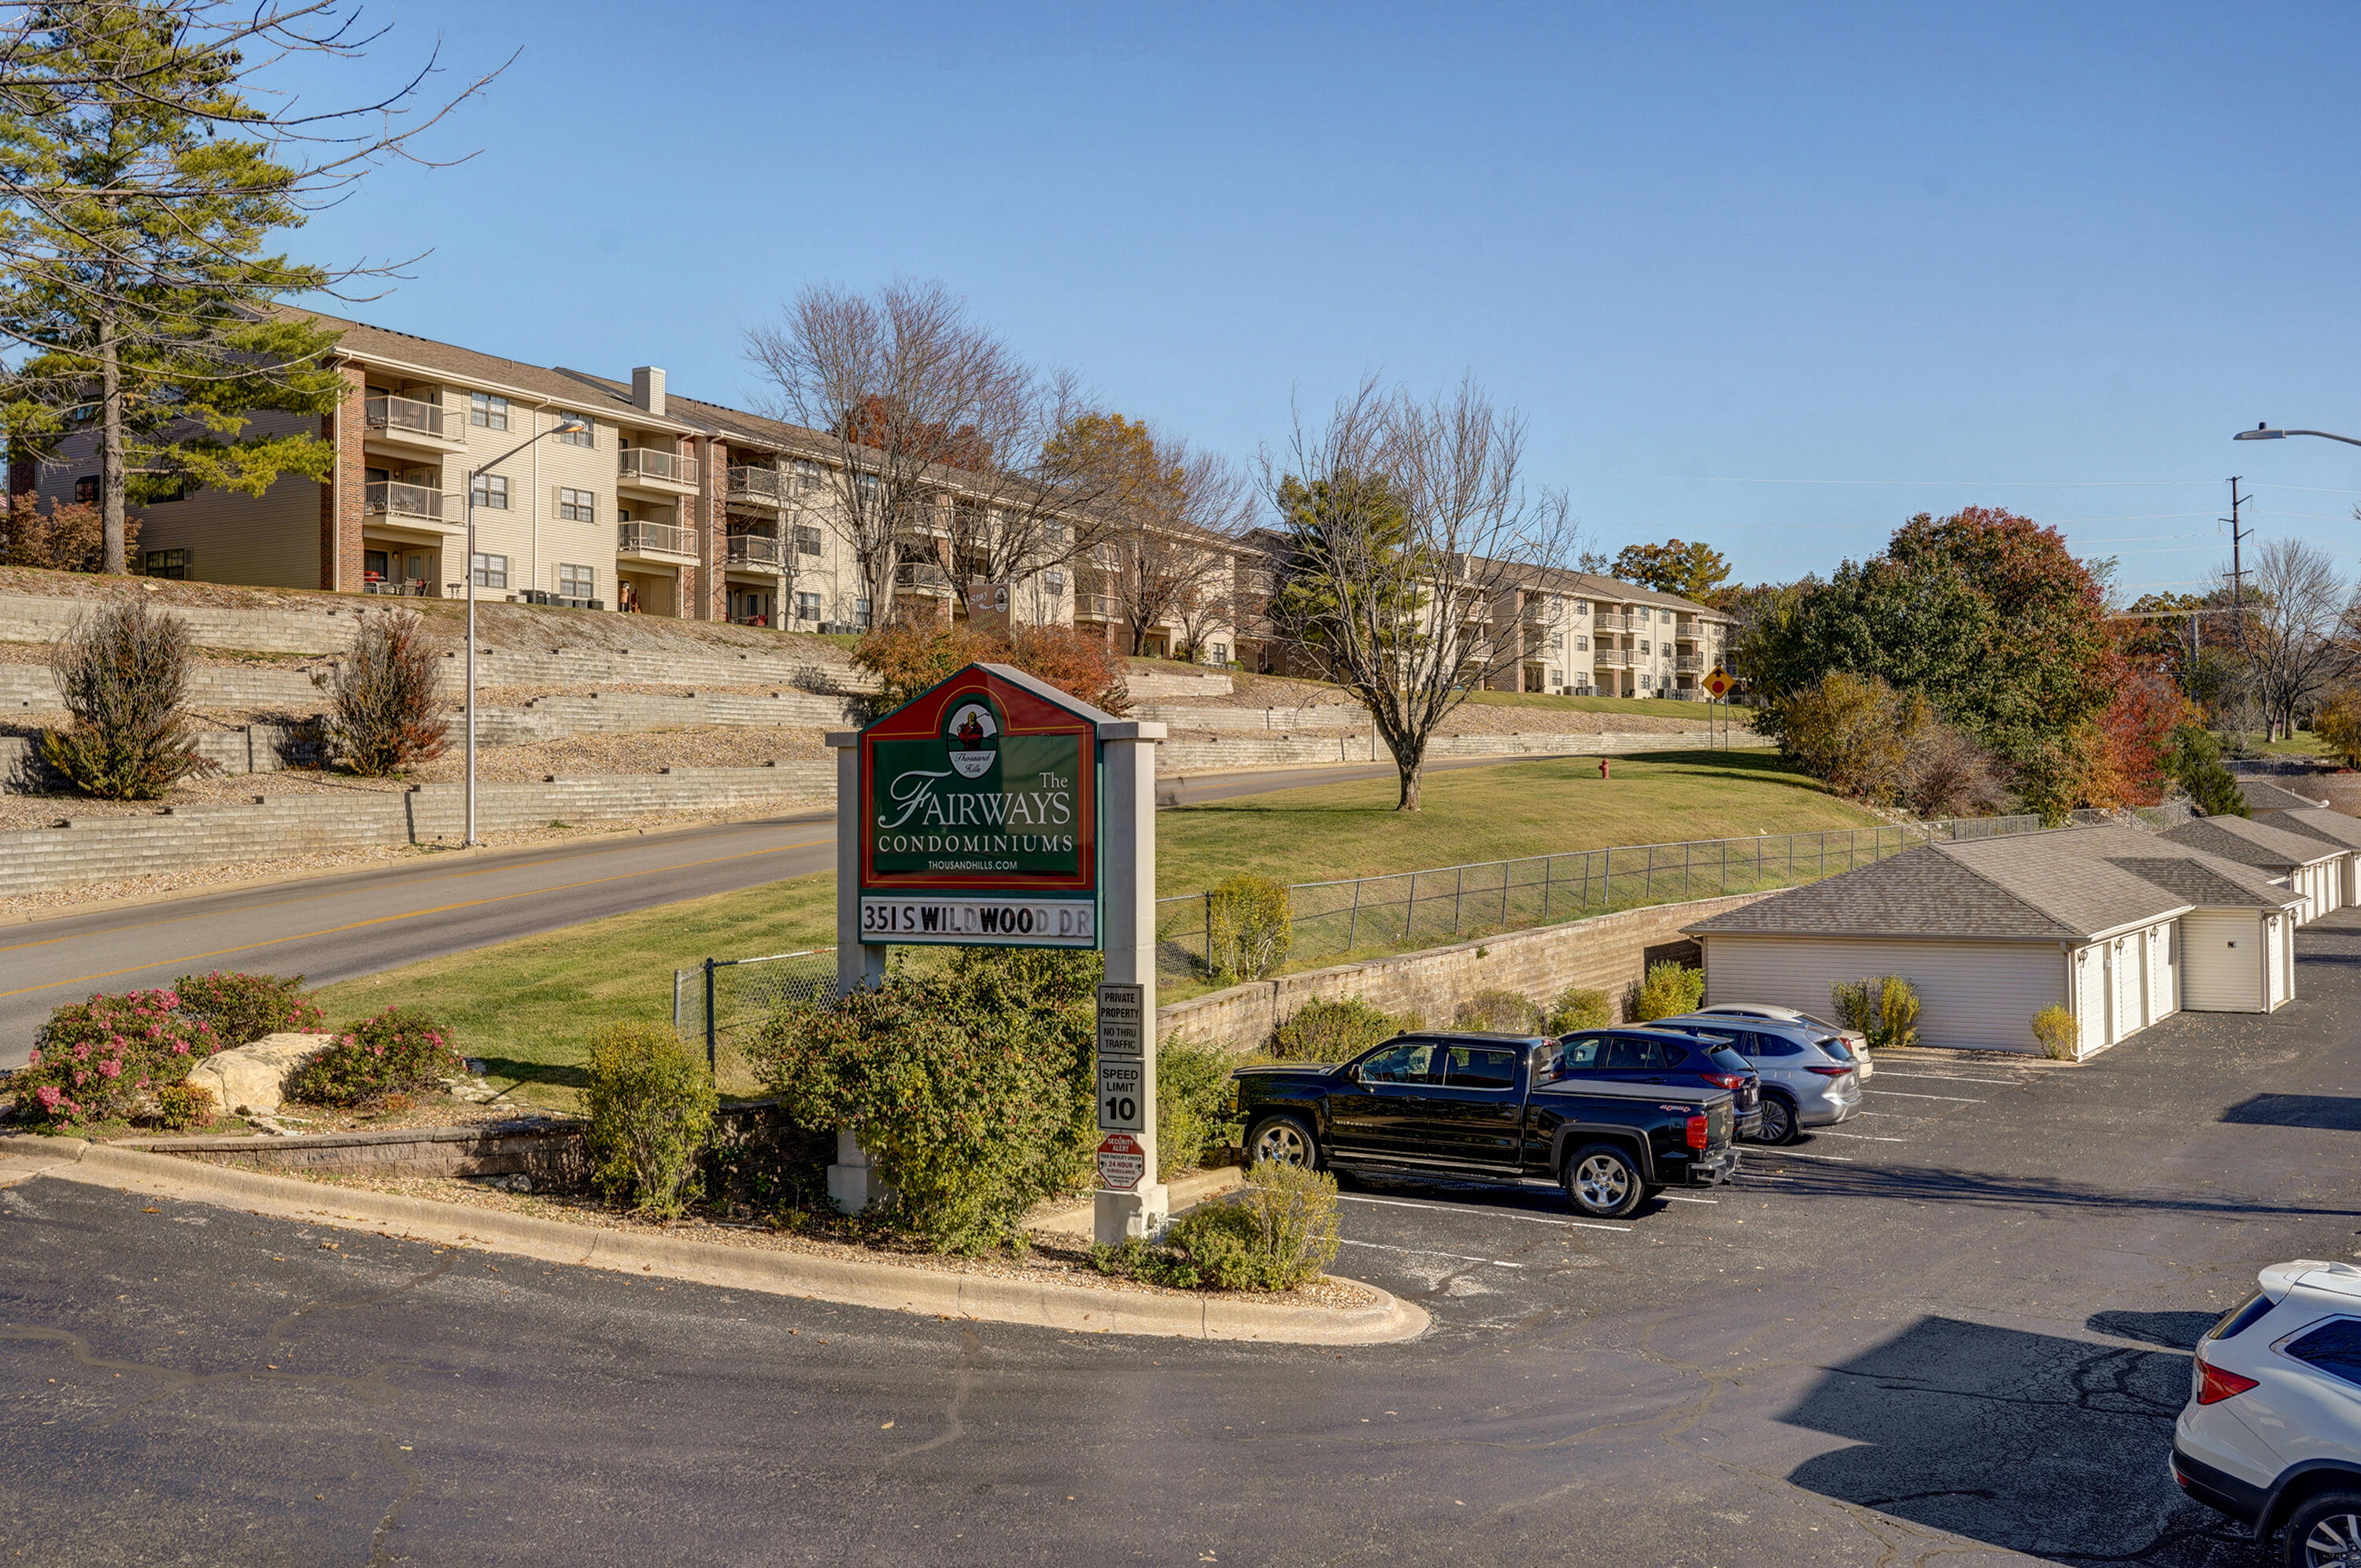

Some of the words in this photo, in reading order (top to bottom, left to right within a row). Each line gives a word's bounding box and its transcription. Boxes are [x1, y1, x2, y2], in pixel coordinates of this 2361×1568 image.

[970, 590, 989, 605] Stay
[954, 752, 992, 762] Thousand
[965, 763, 981, 773] Hills
[1038, 771, 1069, 788] The
[878, 834, 1073, 853] CONDOMINIUMS
[928, 860, 1018, 870] THOUSANDHILLS.COM
[863, 905, 897, 931] 351
[903, 906, 916, 931] S
[920, 906, 1050, 935] WILDWOOD
[1059, 908, 1092, 935] DR
[1104, 992, 1136, 1004] PRIVATE
[1100, 1007, 1140, 1019] PROPERTY
[1103, 1027, 1115, 1037] NO
[1116, 1028, 1137, 1038] THRU
[1104, 1039, 1136, 1050] TRAFFIC
[1102, 1068, 1139, 1080] SPEED
[1106, 1081, 1136, 1093] LIMIT
[1105, 1096, 1136, 1121] 10
[1107, 1138, 1134, 1146] SECURITY
